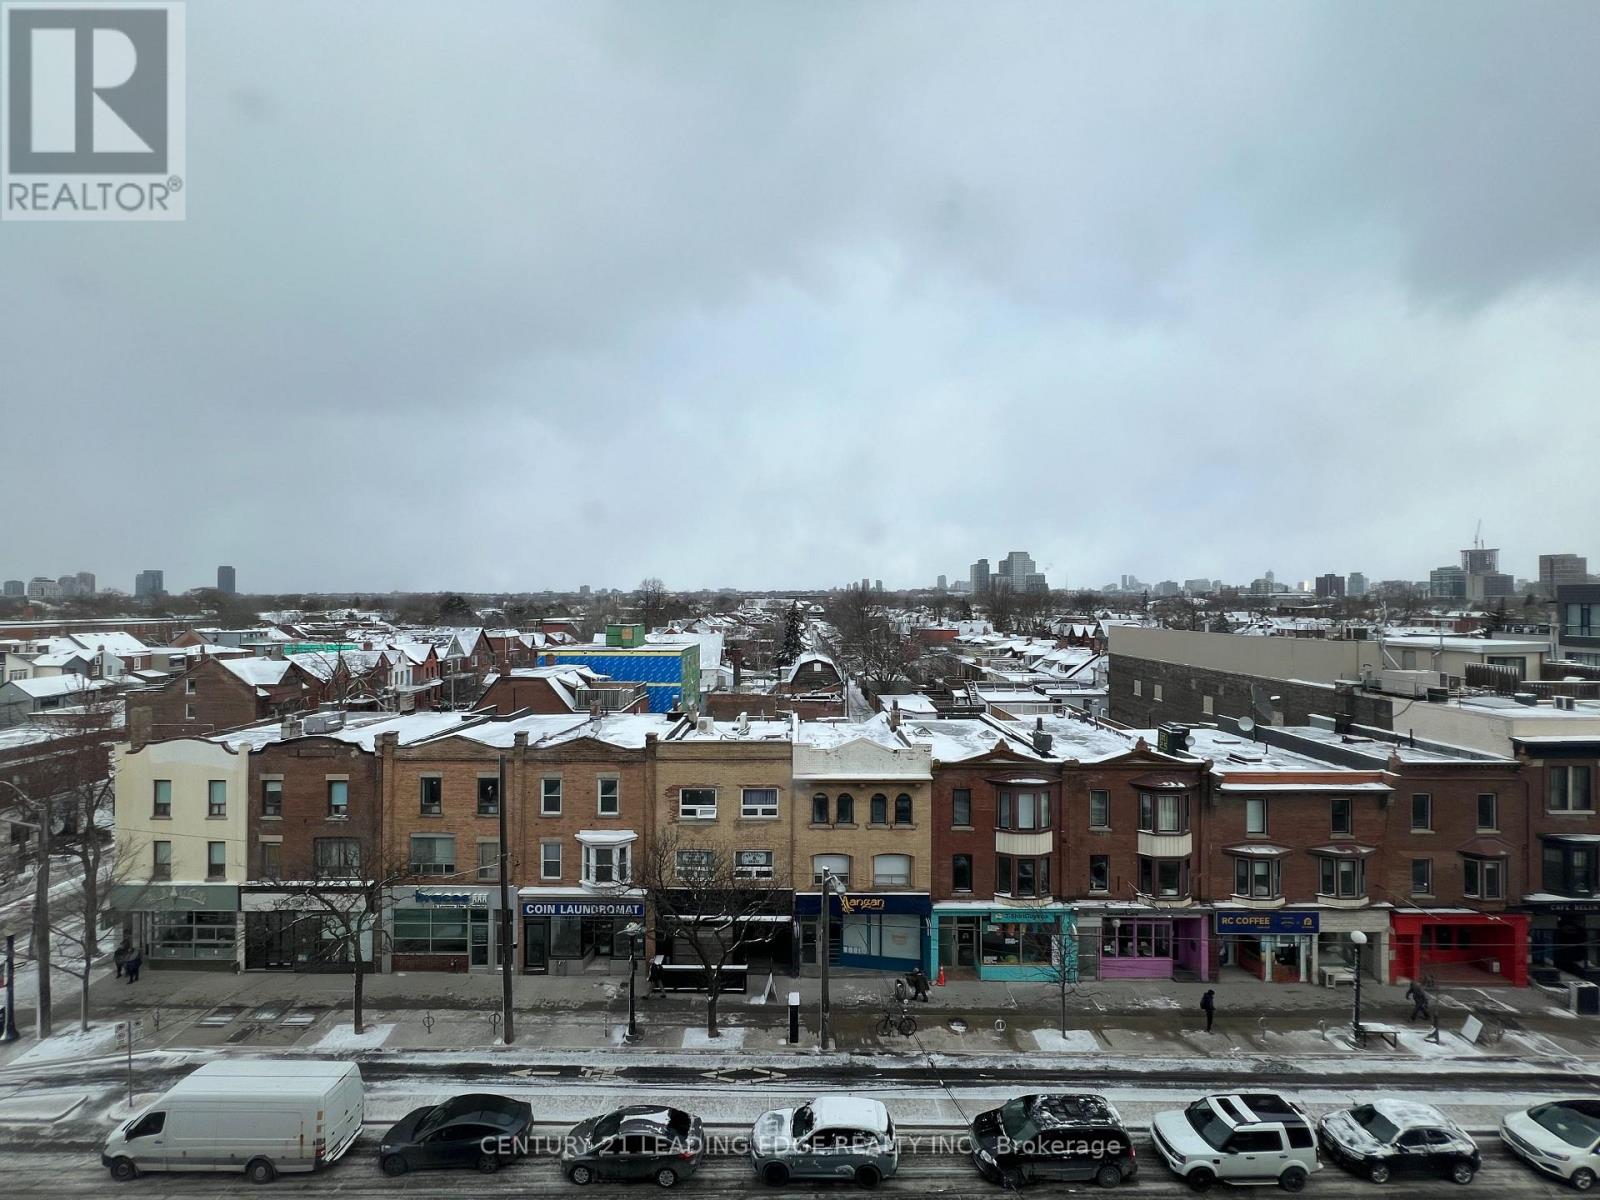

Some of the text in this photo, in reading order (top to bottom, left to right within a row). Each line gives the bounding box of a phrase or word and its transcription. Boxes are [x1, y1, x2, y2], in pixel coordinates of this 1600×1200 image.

[526, 904, 640, 914] COIN LAUNDROMAT
[1221, 917, 1270, 925] RC COFFEE
